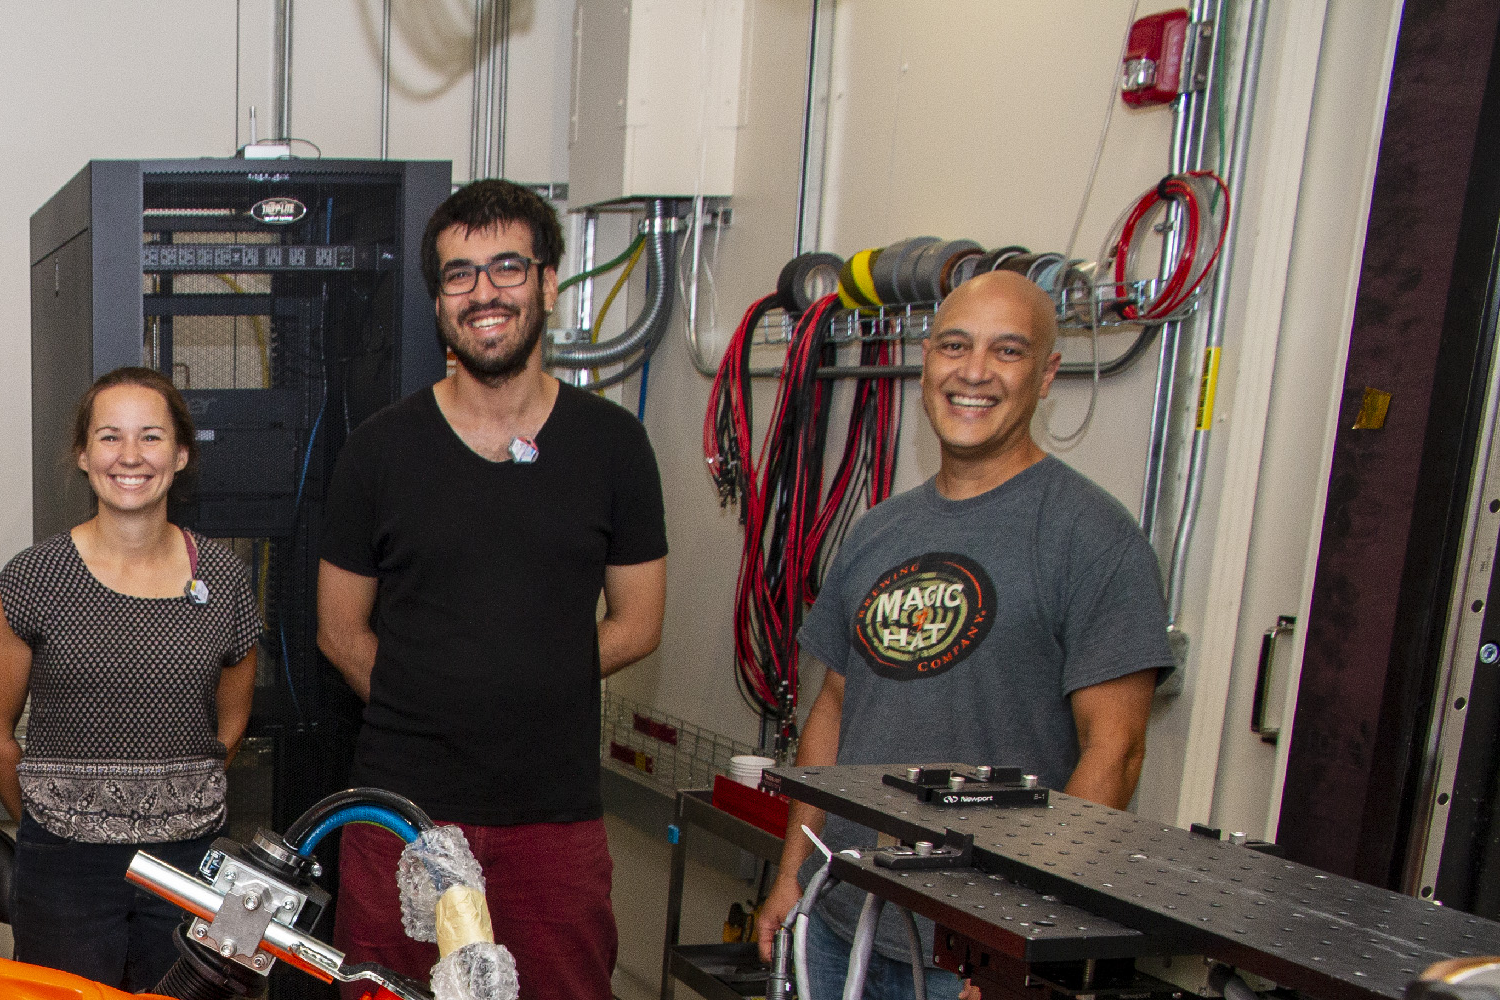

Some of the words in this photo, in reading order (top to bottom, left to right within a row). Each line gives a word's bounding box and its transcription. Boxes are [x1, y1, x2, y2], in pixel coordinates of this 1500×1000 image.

[858, 563, 920, 618] BREWING
[876, 583, 965, 622] MAGIC
[882, 622, 948, 650] HAT
[961, 795, 994, 804] Newport
